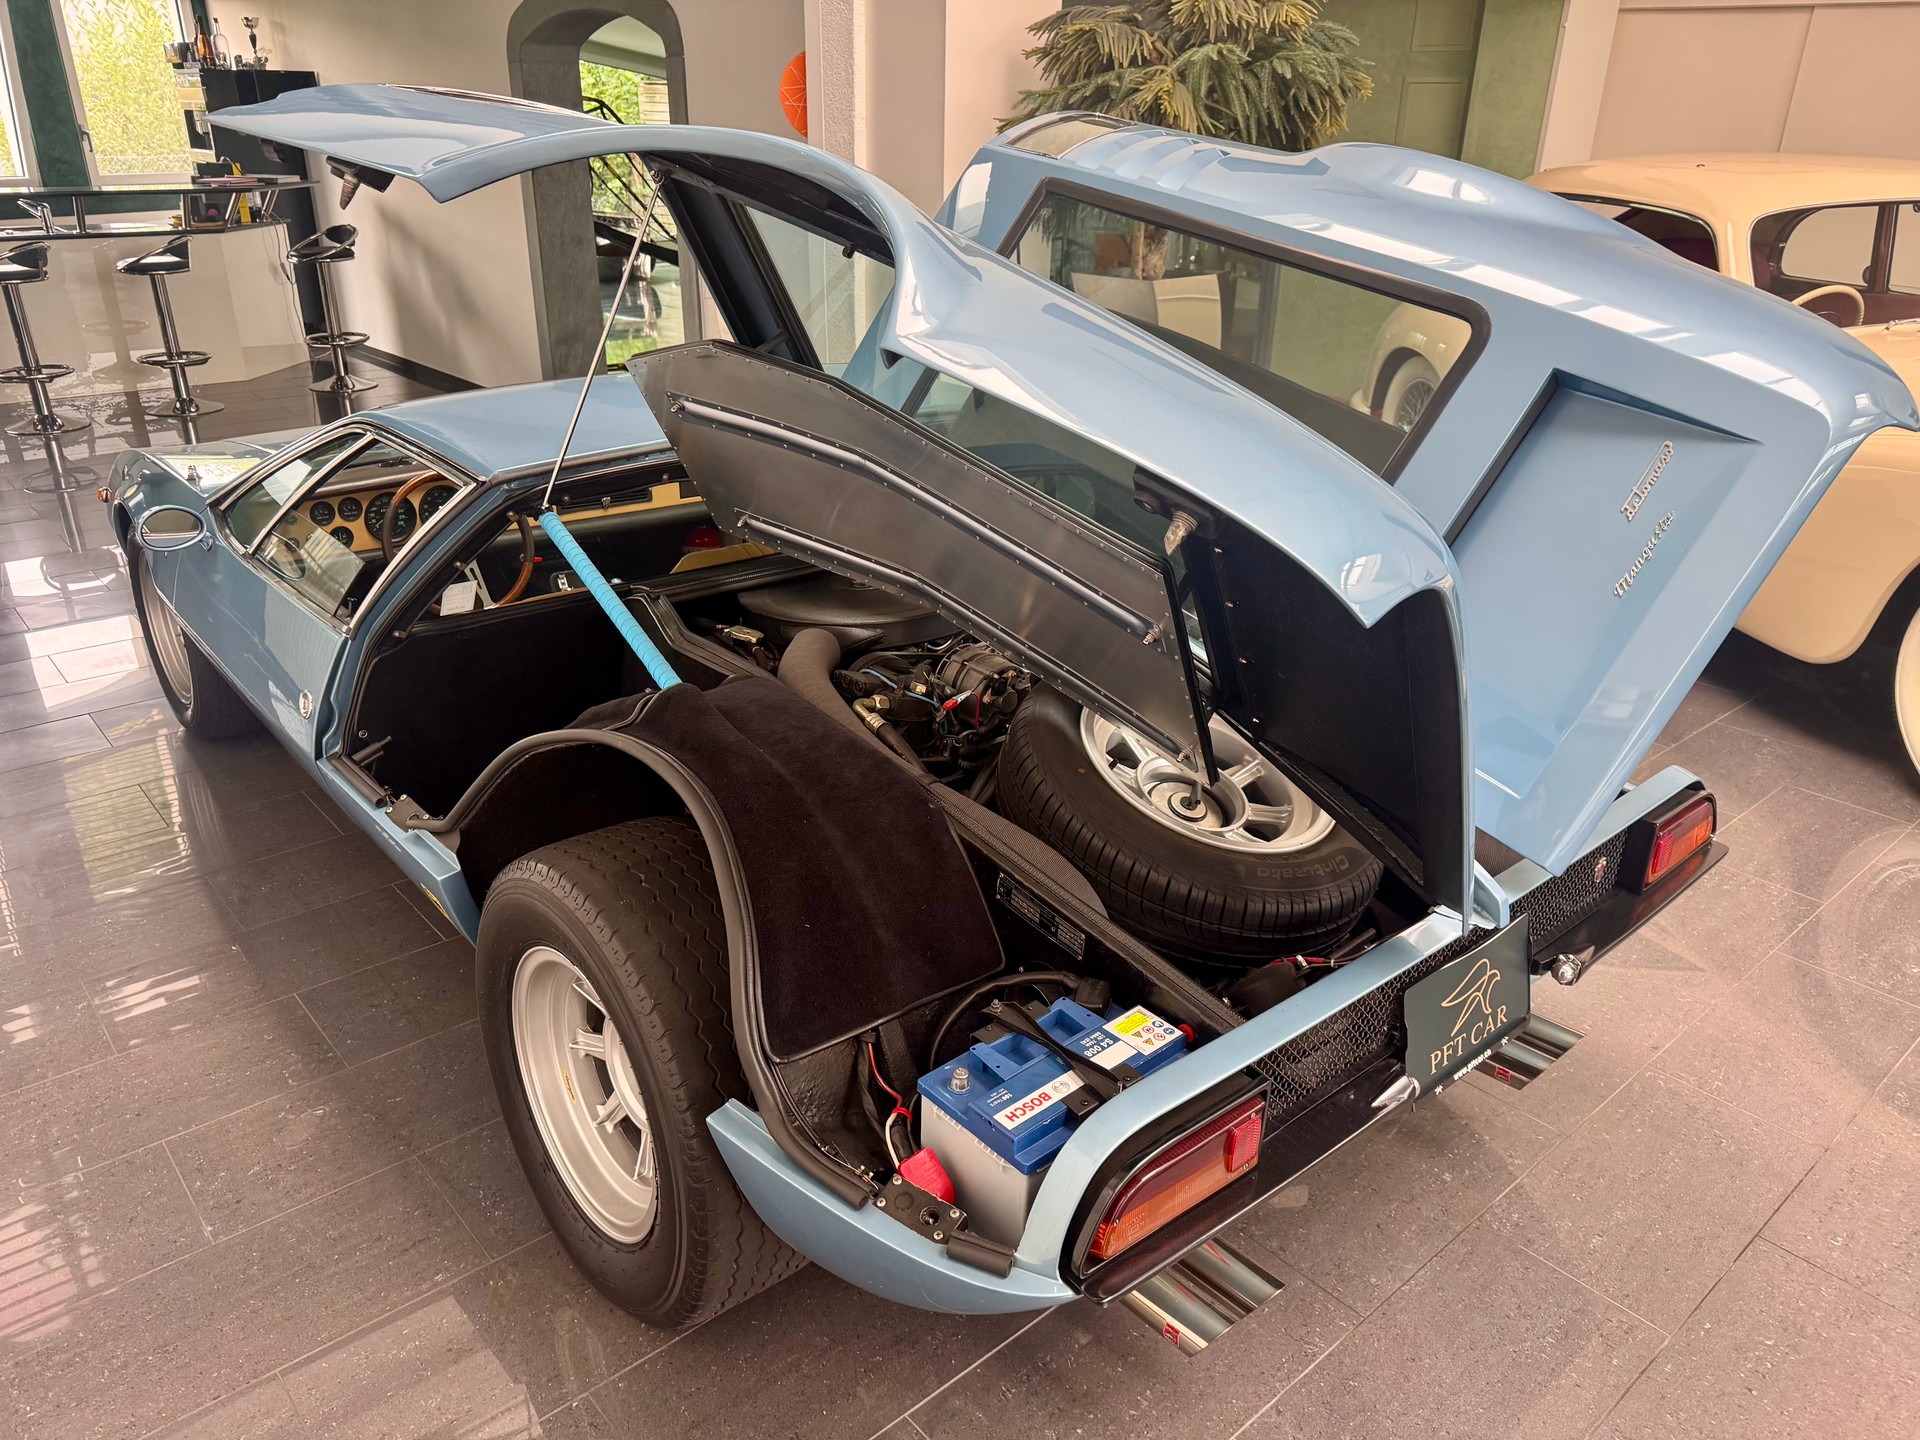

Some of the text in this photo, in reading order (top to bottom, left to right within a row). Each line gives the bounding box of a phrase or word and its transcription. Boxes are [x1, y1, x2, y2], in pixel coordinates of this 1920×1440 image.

[1257, 854, 1349, 879] Cinturato
[1084, 1038, 1113, 1056] S4 008
[1430, 1005, 1507, 1075] PFT CAR
[1453, 1048, 1492, 1081] www.pftcar.ch
[1004, 1091, 1053, 1122] BOSCH
